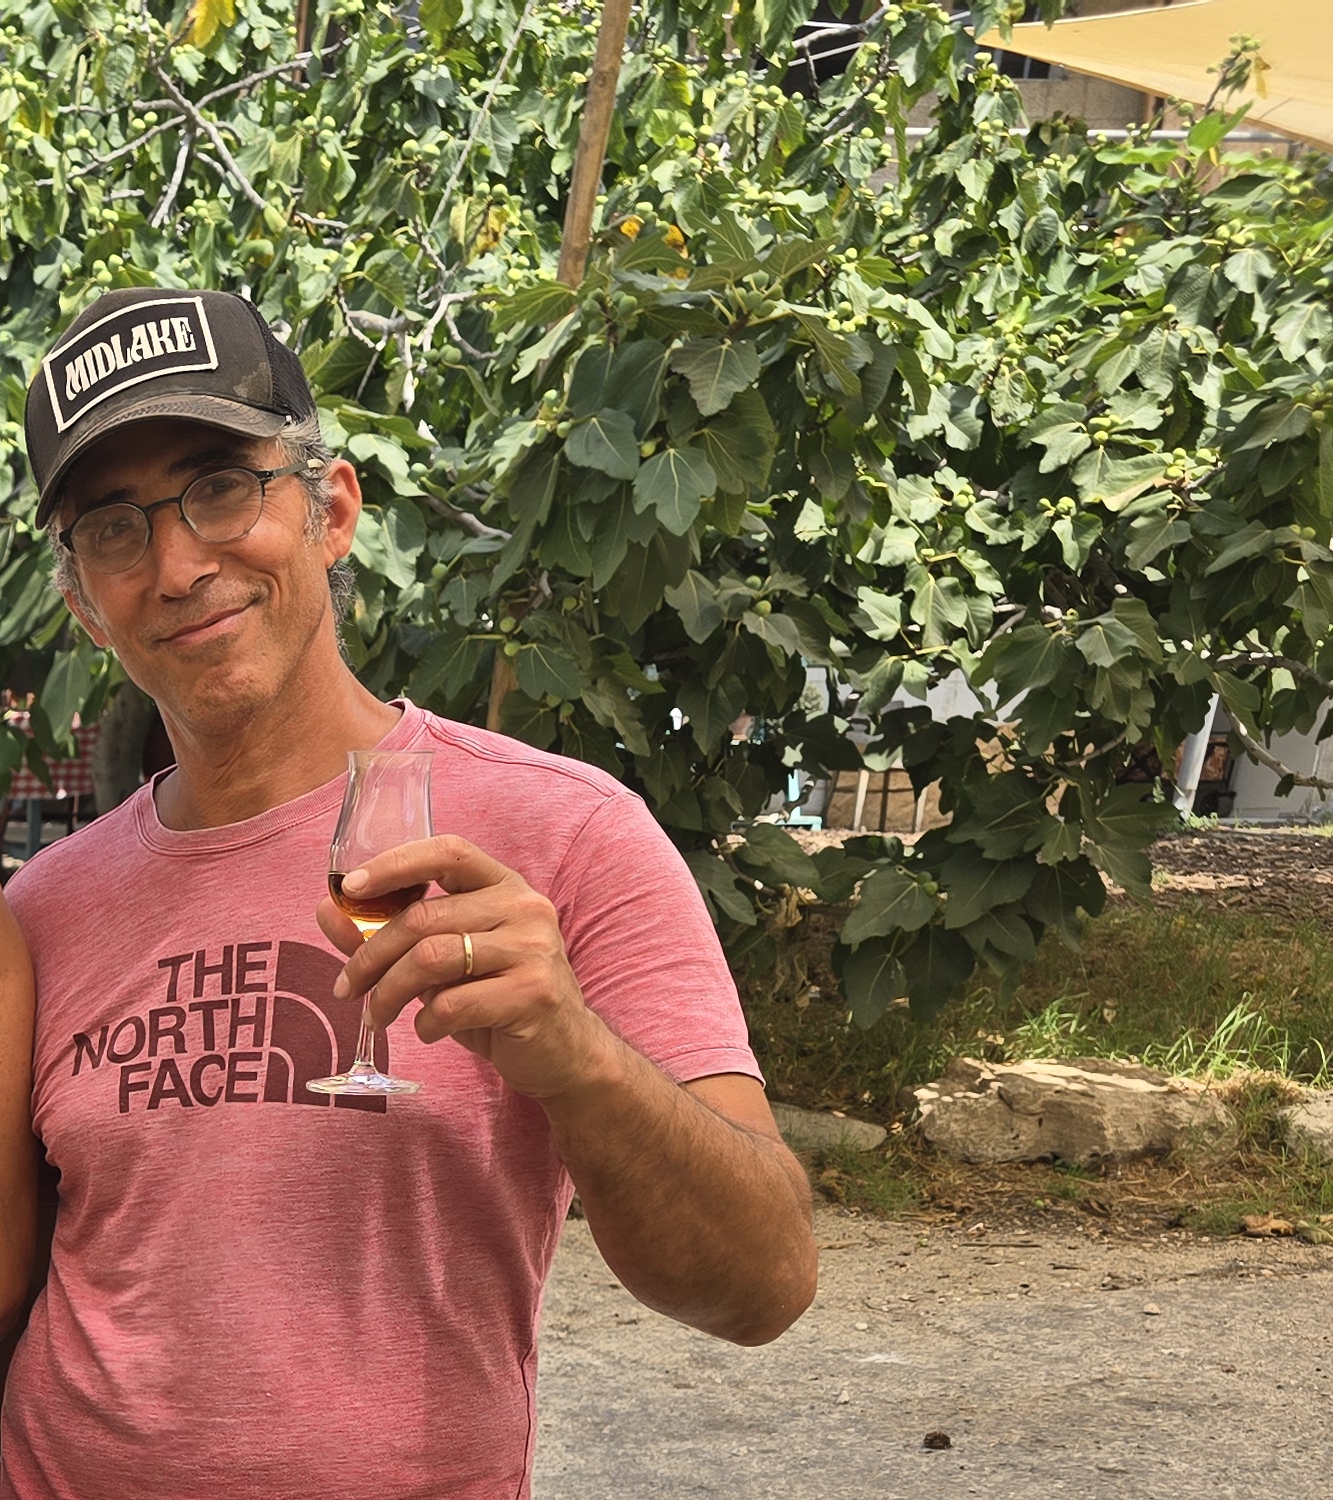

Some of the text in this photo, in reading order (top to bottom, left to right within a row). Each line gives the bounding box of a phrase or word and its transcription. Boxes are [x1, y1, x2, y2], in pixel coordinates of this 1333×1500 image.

[64, 316, 197, 402] MIDLAKE
[157, 940, 273, 1003] THE
[71, 996, 268, 1077] NORTH
[118, 1051, 263, 1114] FACE
